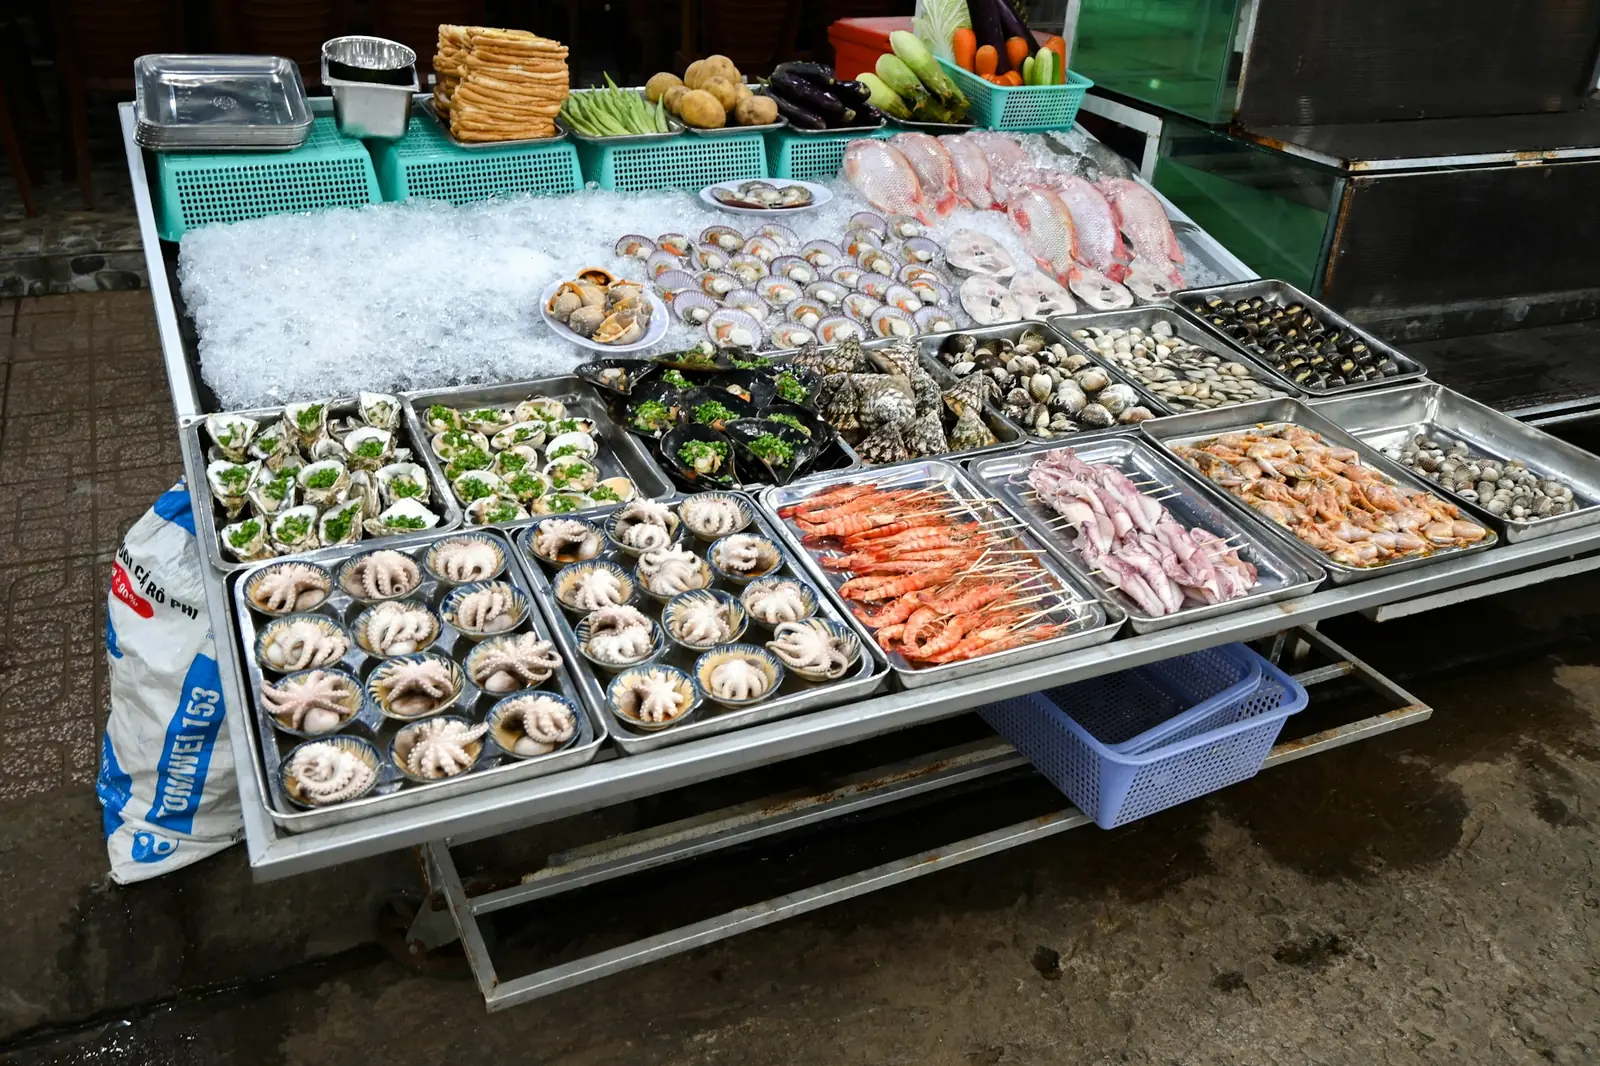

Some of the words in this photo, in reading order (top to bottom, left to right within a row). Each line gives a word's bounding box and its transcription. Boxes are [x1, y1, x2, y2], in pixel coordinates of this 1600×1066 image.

[145, 581, 165, 604] RÔ
[170, 598, 199, 620] PHI
[182, 686, 221, 728] 153
